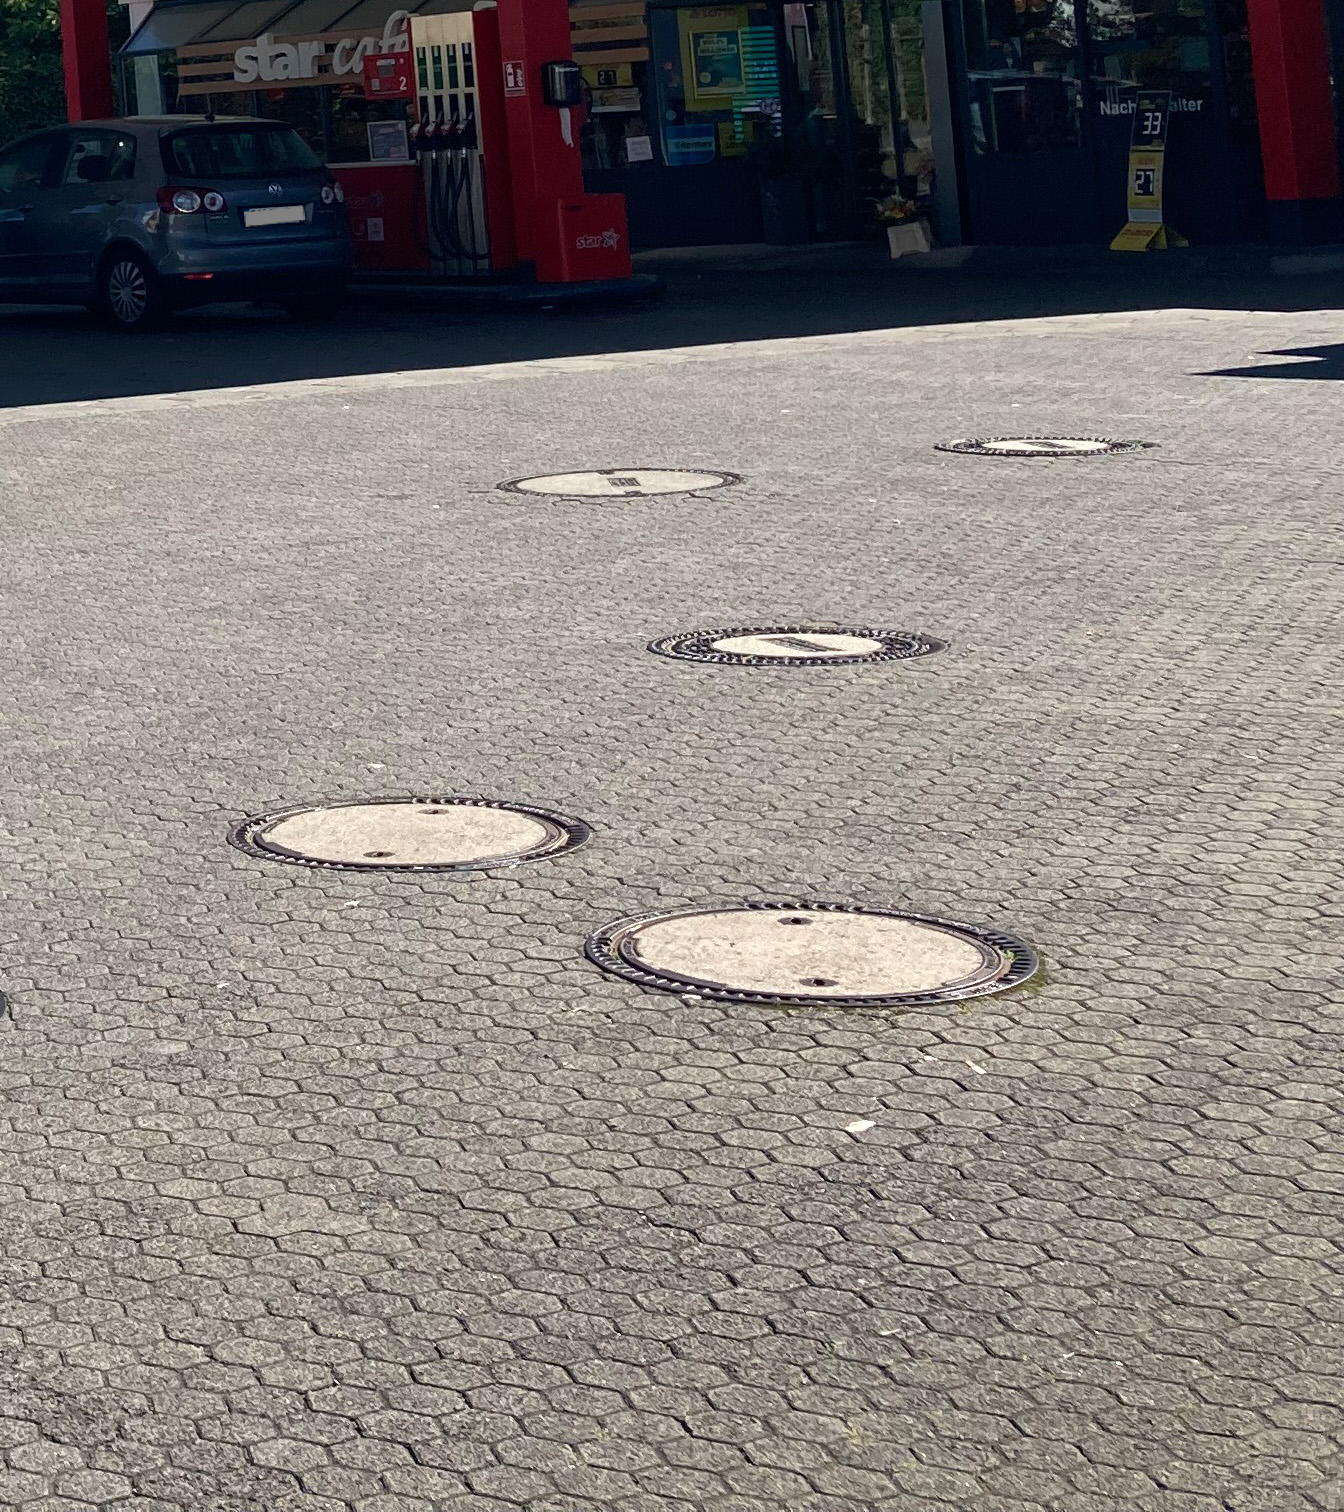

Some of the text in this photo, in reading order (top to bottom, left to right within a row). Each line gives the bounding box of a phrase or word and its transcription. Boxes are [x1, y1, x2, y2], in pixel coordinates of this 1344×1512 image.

[233, 33, 325, 84] star
[399, 76, 408, 90] 2
[1142, 111, 1162, 135] 33
[1135, 170, 1153, 194] 27
[576, 233, 602, 249] star
